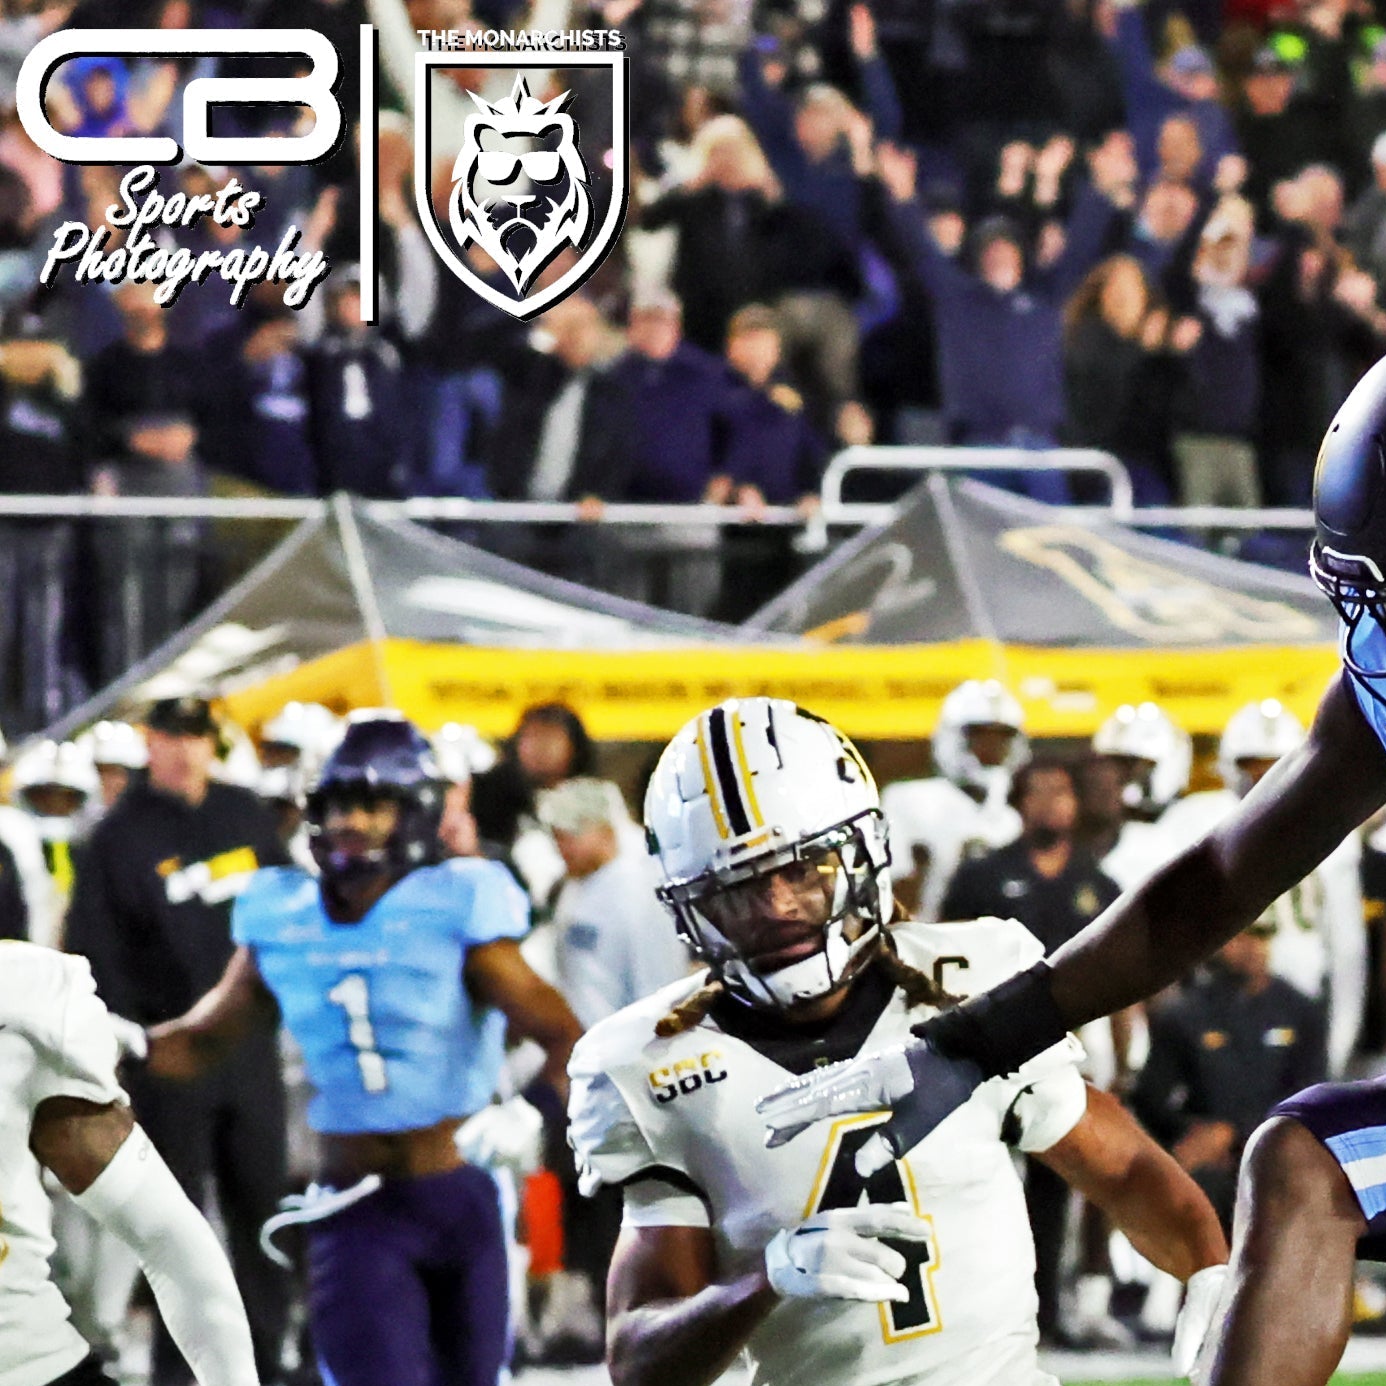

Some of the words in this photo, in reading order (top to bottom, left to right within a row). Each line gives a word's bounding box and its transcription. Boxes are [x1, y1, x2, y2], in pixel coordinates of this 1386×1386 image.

[329, 974, 389, 1094] 1
[649, 1050, 728, 1104] SBC
[802, 1110, 944, 1346] 4
